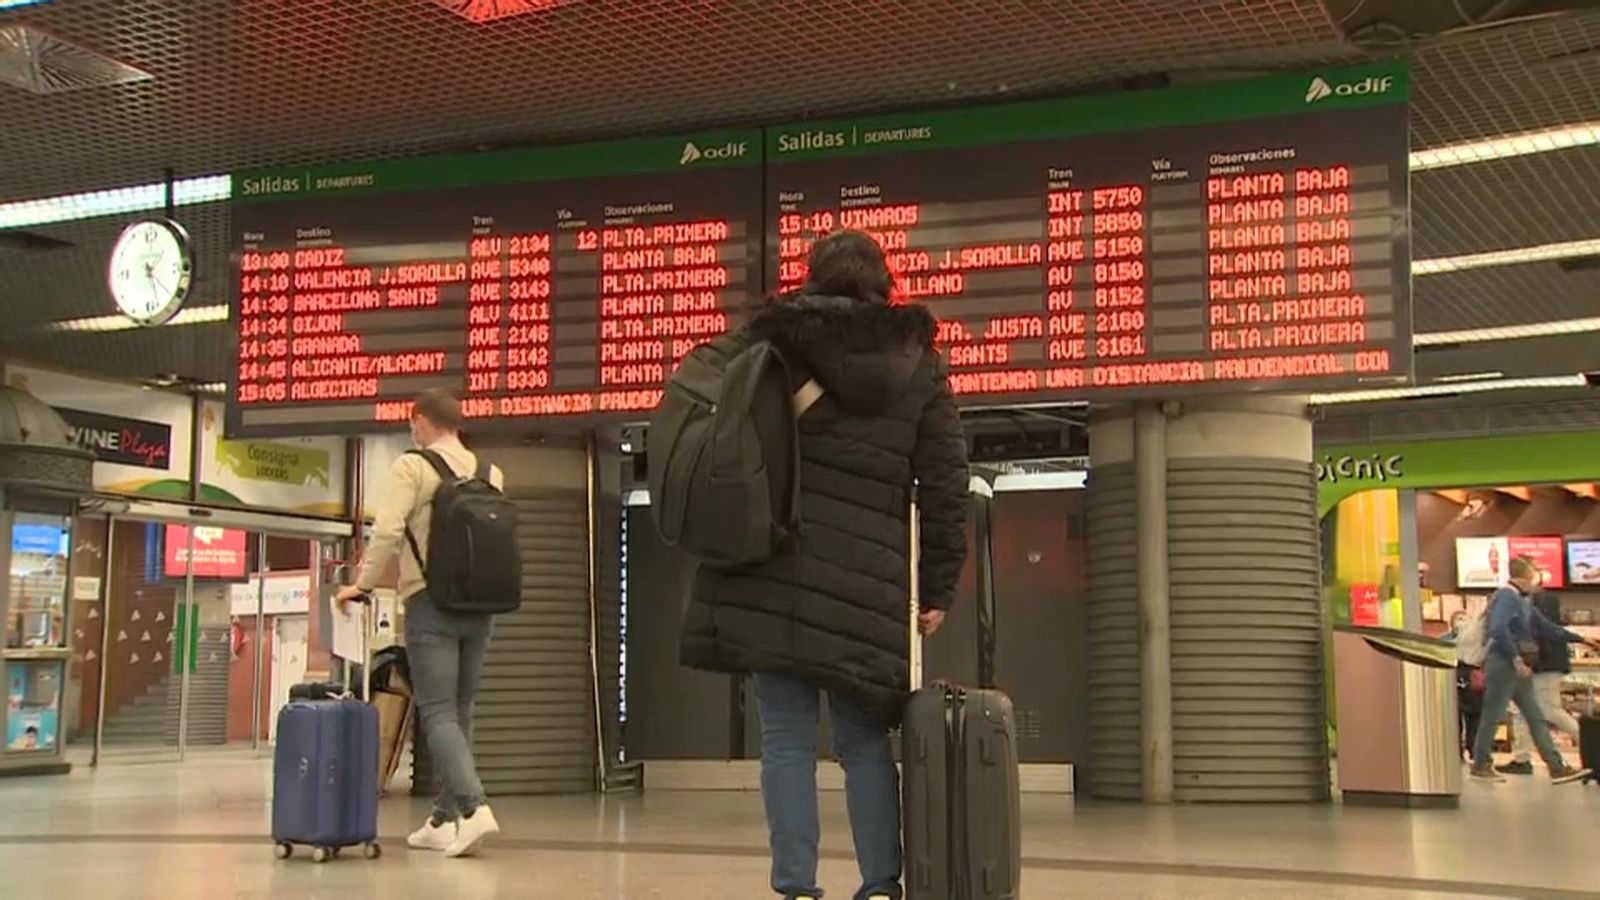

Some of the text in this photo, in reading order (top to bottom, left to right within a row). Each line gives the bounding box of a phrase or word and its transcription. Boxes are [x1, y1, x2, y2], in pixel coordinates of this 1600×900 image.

[1334, 76, 1394, 97] adif
[703, 142, 748, 159] adif
[778, 127, 931, 151] Salidas DEPARTURES
[242, 174, 374, 195] Salidas DEPARTURES
[841, 185, 880, 197] Destino
[1048, 168, 1073, 179] Tren
[1152, 158, 1171, 170] Vía
[1209, 148, 1296, 165] Observaciones
[604, 202, 674, 217] Observaciones
[780, 166, 1348, 234] 15:10 VINAROS INT 5750 PLANTA BAJA
[1048, 215, 1083, 237] INT
[1094, 211, 1143, 234] 5850
[1208, 199, 1284, 225] PLANTA
[1296, 193, 1348, 216] BAJA
[242, 221, 727, 271] 13:30 CADIZ ALV 2134 12 PLTA.PRIMERA
[939, 244, 1041, 270] J.SOROLLA
[1048, 240, 1084, 262] AVE
[1094, 236, 1143, 258] 5150
[1208, 225, 1284, 250] PLANTA
[1296, 218, 1349, 242] BAJA
[1048, 265, 1072, 286] AV
[1095, 260, 1144, 283] 8150
[1209, 251, 1285, 275] PLANTA
[1297, 244, 1350, 268] BAJA
[241, 245, 716, 293] 14:10 VALENCIA J.SOROLLA AVE 5340 PLANTA BAJA
[1048, 269, 1350, 311] AV 8152 PLANTA BAJA
[241, 268, 727, 315] 14:30 BARCELONA SANTS AVE 3143 PLTA.PRIMERA
[241, 317, 287, 336] 14:34
[470, 304, 501, 324] ALV
[508, 301, 549, 322] 4111
[602, 295, 664, 317] PLANTA
[673, 292, 716, 312] BAJA
[984, 316, 1042, 340] JUSTA
[1049, 314, 1085, 336] AVE
[1096, 310, 1145, 333] 2160
[1211, 296, 1365, 325] PLTA.PRIMERA
[240, 314, 726, 358] 14:35 GRANADA AVE 2146 PLTA.PRIMERA
[949, 322, 1366, 366] SANTS AVE 3161 PLTA.PRIMERA
[239, 338, 711, 380] 14:45 ALICANTE/ALACANT AVE 5142 PLANTA BA
[1046, 367, 1084, 389] UNA
[1093, 360, 1205, 386] DISTANCIA
[1214, 353, 1344, 380] PRUDENCIAL
[238, 382, 286, 402] 15:05
[291, 378, 378, 401] ALGECIRAS
[469, 372, 500, 392] INT
[507, 369, 548, 390] 9330
[601, 364, 663, 385] PLANTA
[461, 397, 493, 417] UNA
[500, 393, 592, 414] DISTANCIA
[600, 389, 665, 410] PRUDEN
